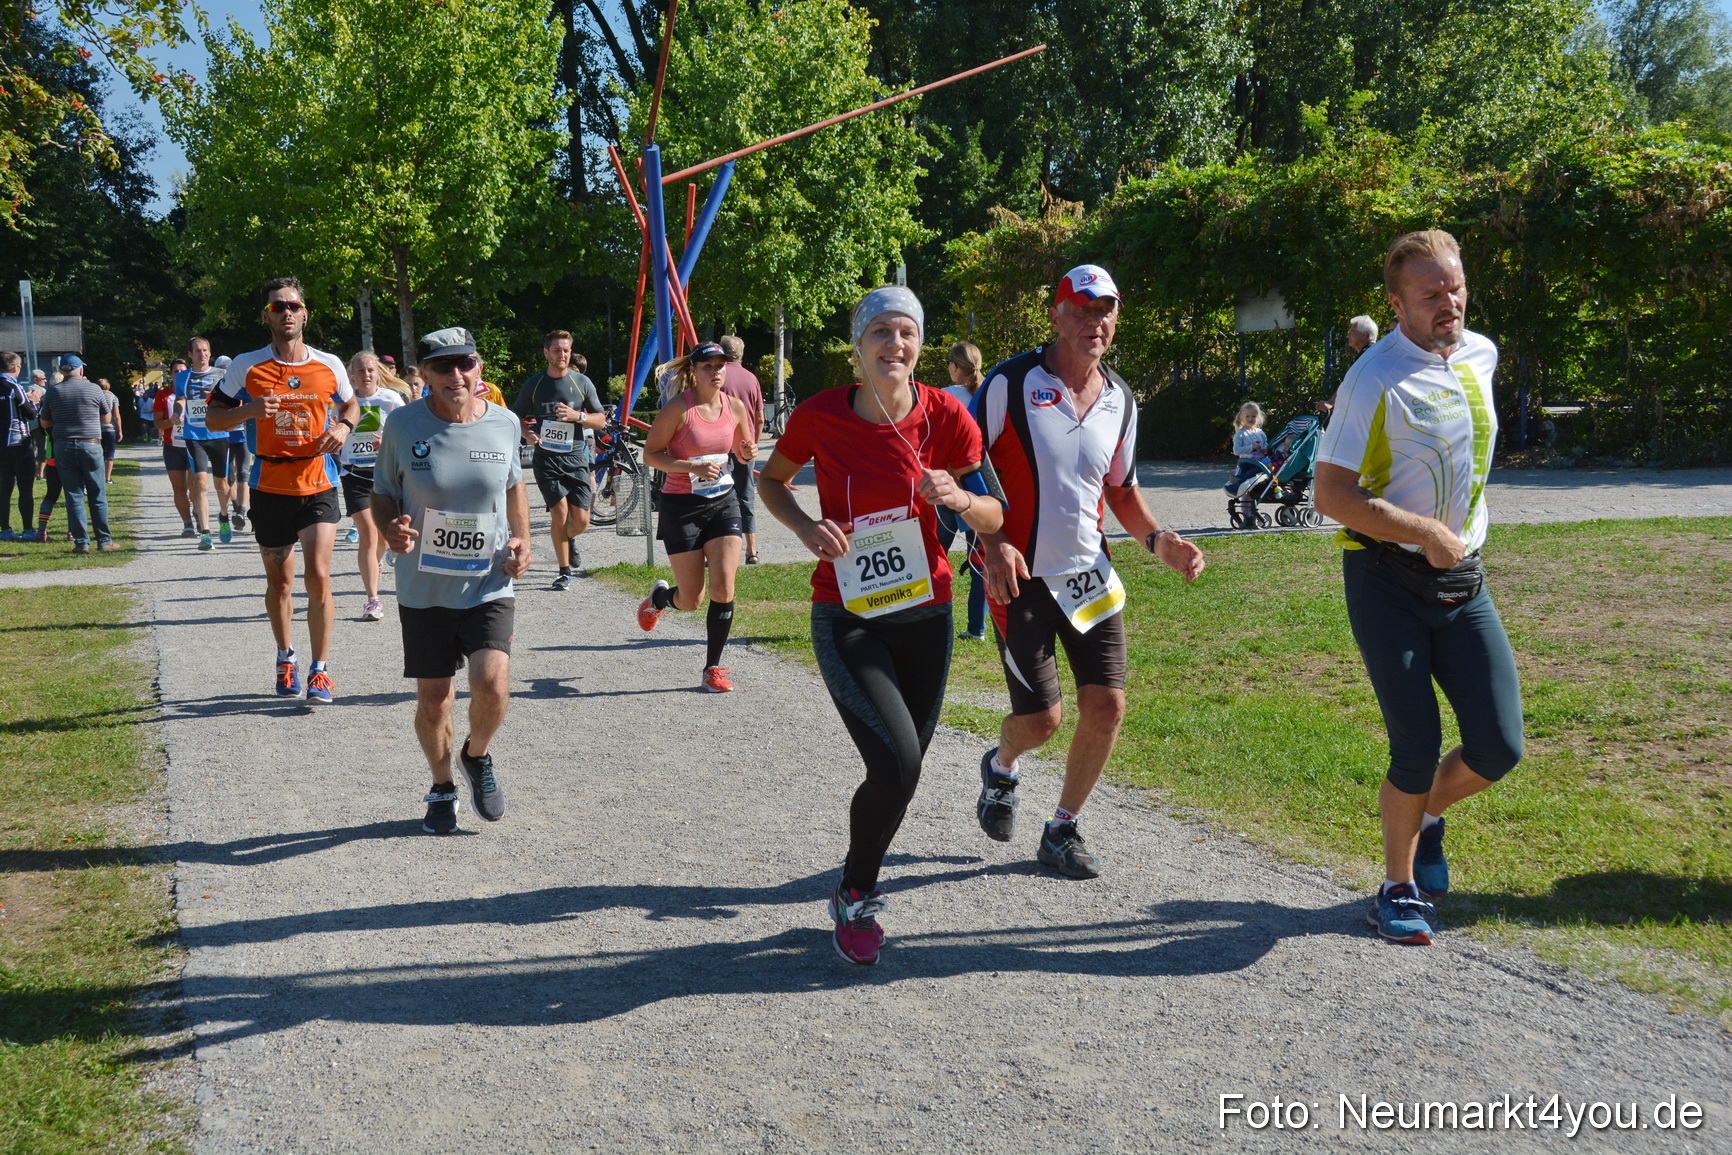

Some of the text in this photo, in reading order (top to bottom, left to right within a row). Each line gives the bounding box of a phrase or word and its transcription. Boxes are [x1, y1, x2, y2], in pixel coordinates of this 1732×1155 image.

[1031, 389, 1053, 400] tkn
[192, 406, 208, 415] 200
[1414, 399, 1460, 417] Rothsee
[1416, 409, 1466, 427] Triathlon
[275, 429, 310, 437] Nürnberg
[545, 429, 568, 440] 2561
[352, 442, 376, 454] 226
[470, 451, 506, 461] BOCK
[445, 517, 477, 527] BOCK
[868, 513, 893, 526] DEHN
[433, 528, 485, 550] 3056
[854, 531, 894, 549] BOCK
[856, 546, 906, 582] 266
[860, 576, 905, 592] PARTL Neumarkt
[1066, 568, 1105, 600] 321
[866, 588, 913, 608] Veronika
[1437, 590, 1469, 599] Reebok
